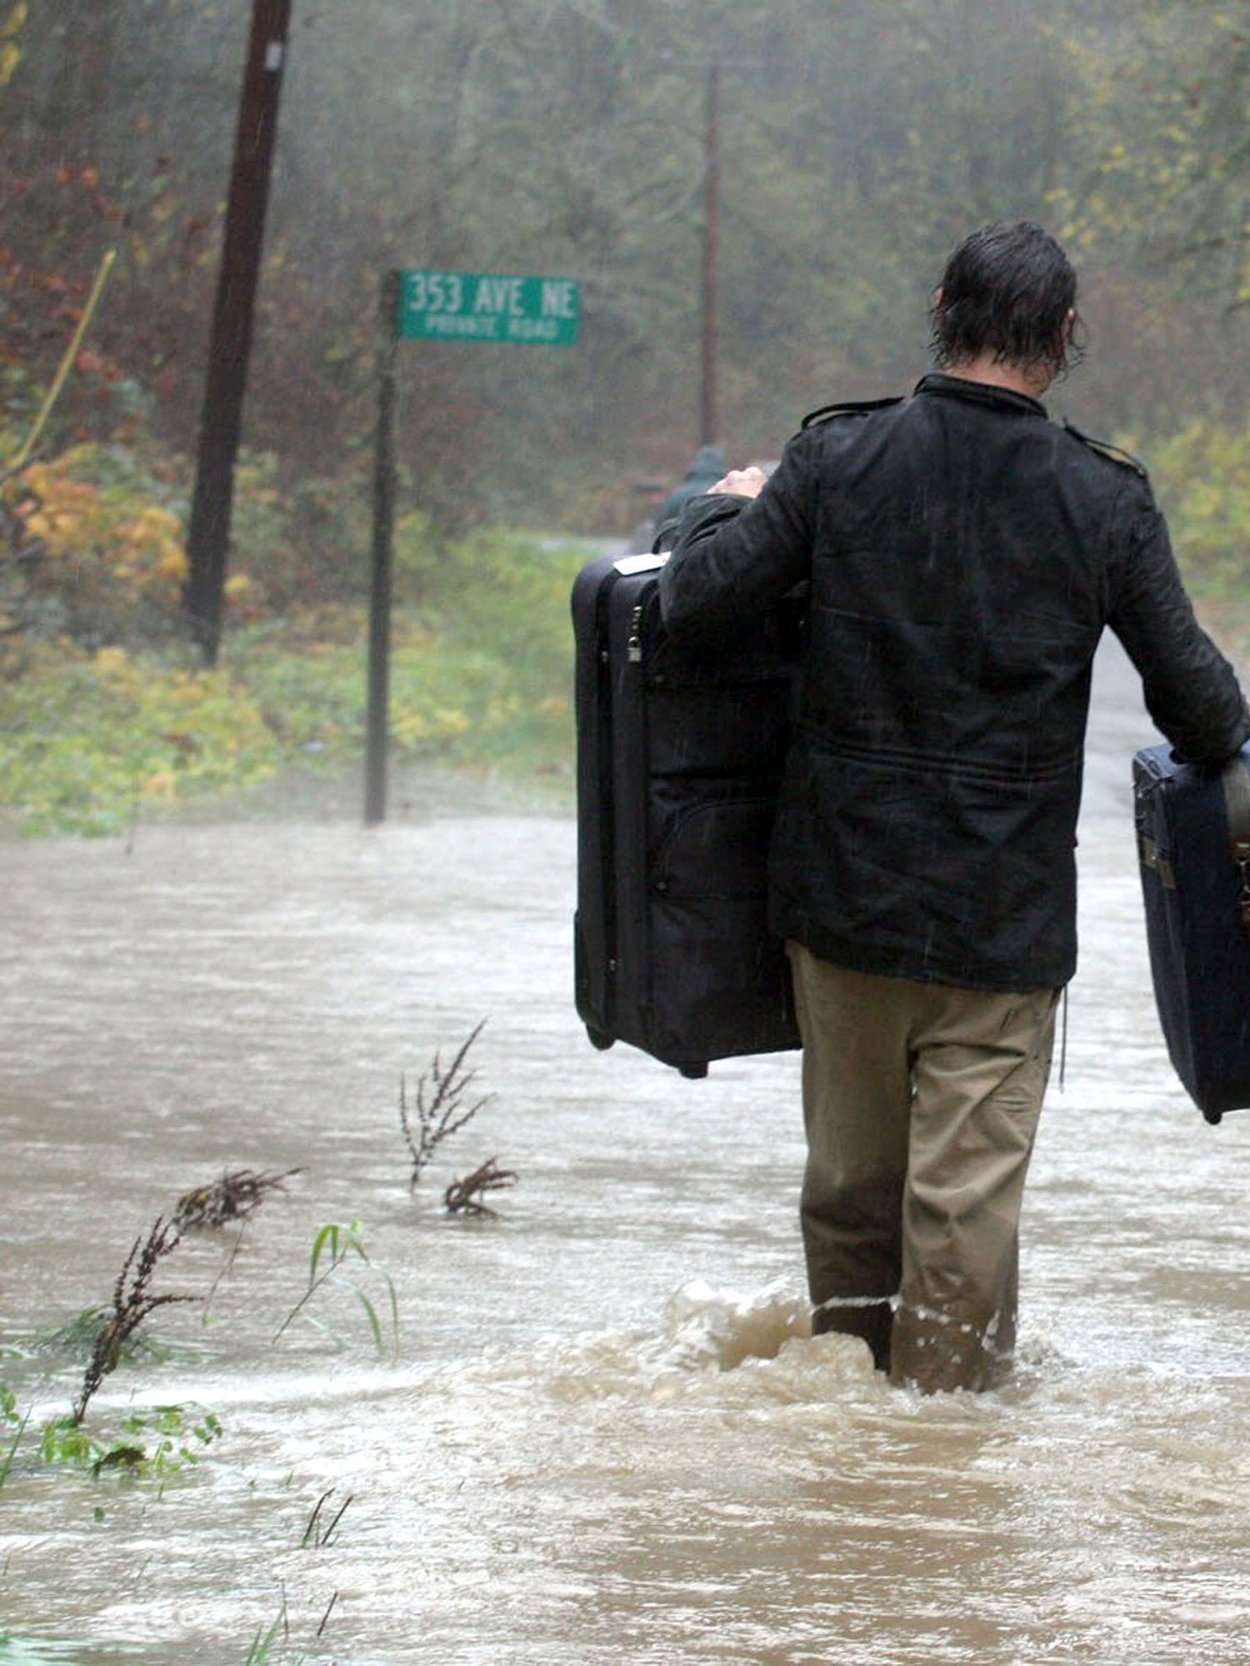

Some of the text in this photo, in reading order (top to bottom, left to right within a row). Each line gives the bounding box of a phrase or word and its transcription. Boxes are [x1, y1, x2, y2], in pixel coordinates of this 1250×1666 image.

[409, 273, 576, 318] 353 AVE NE
